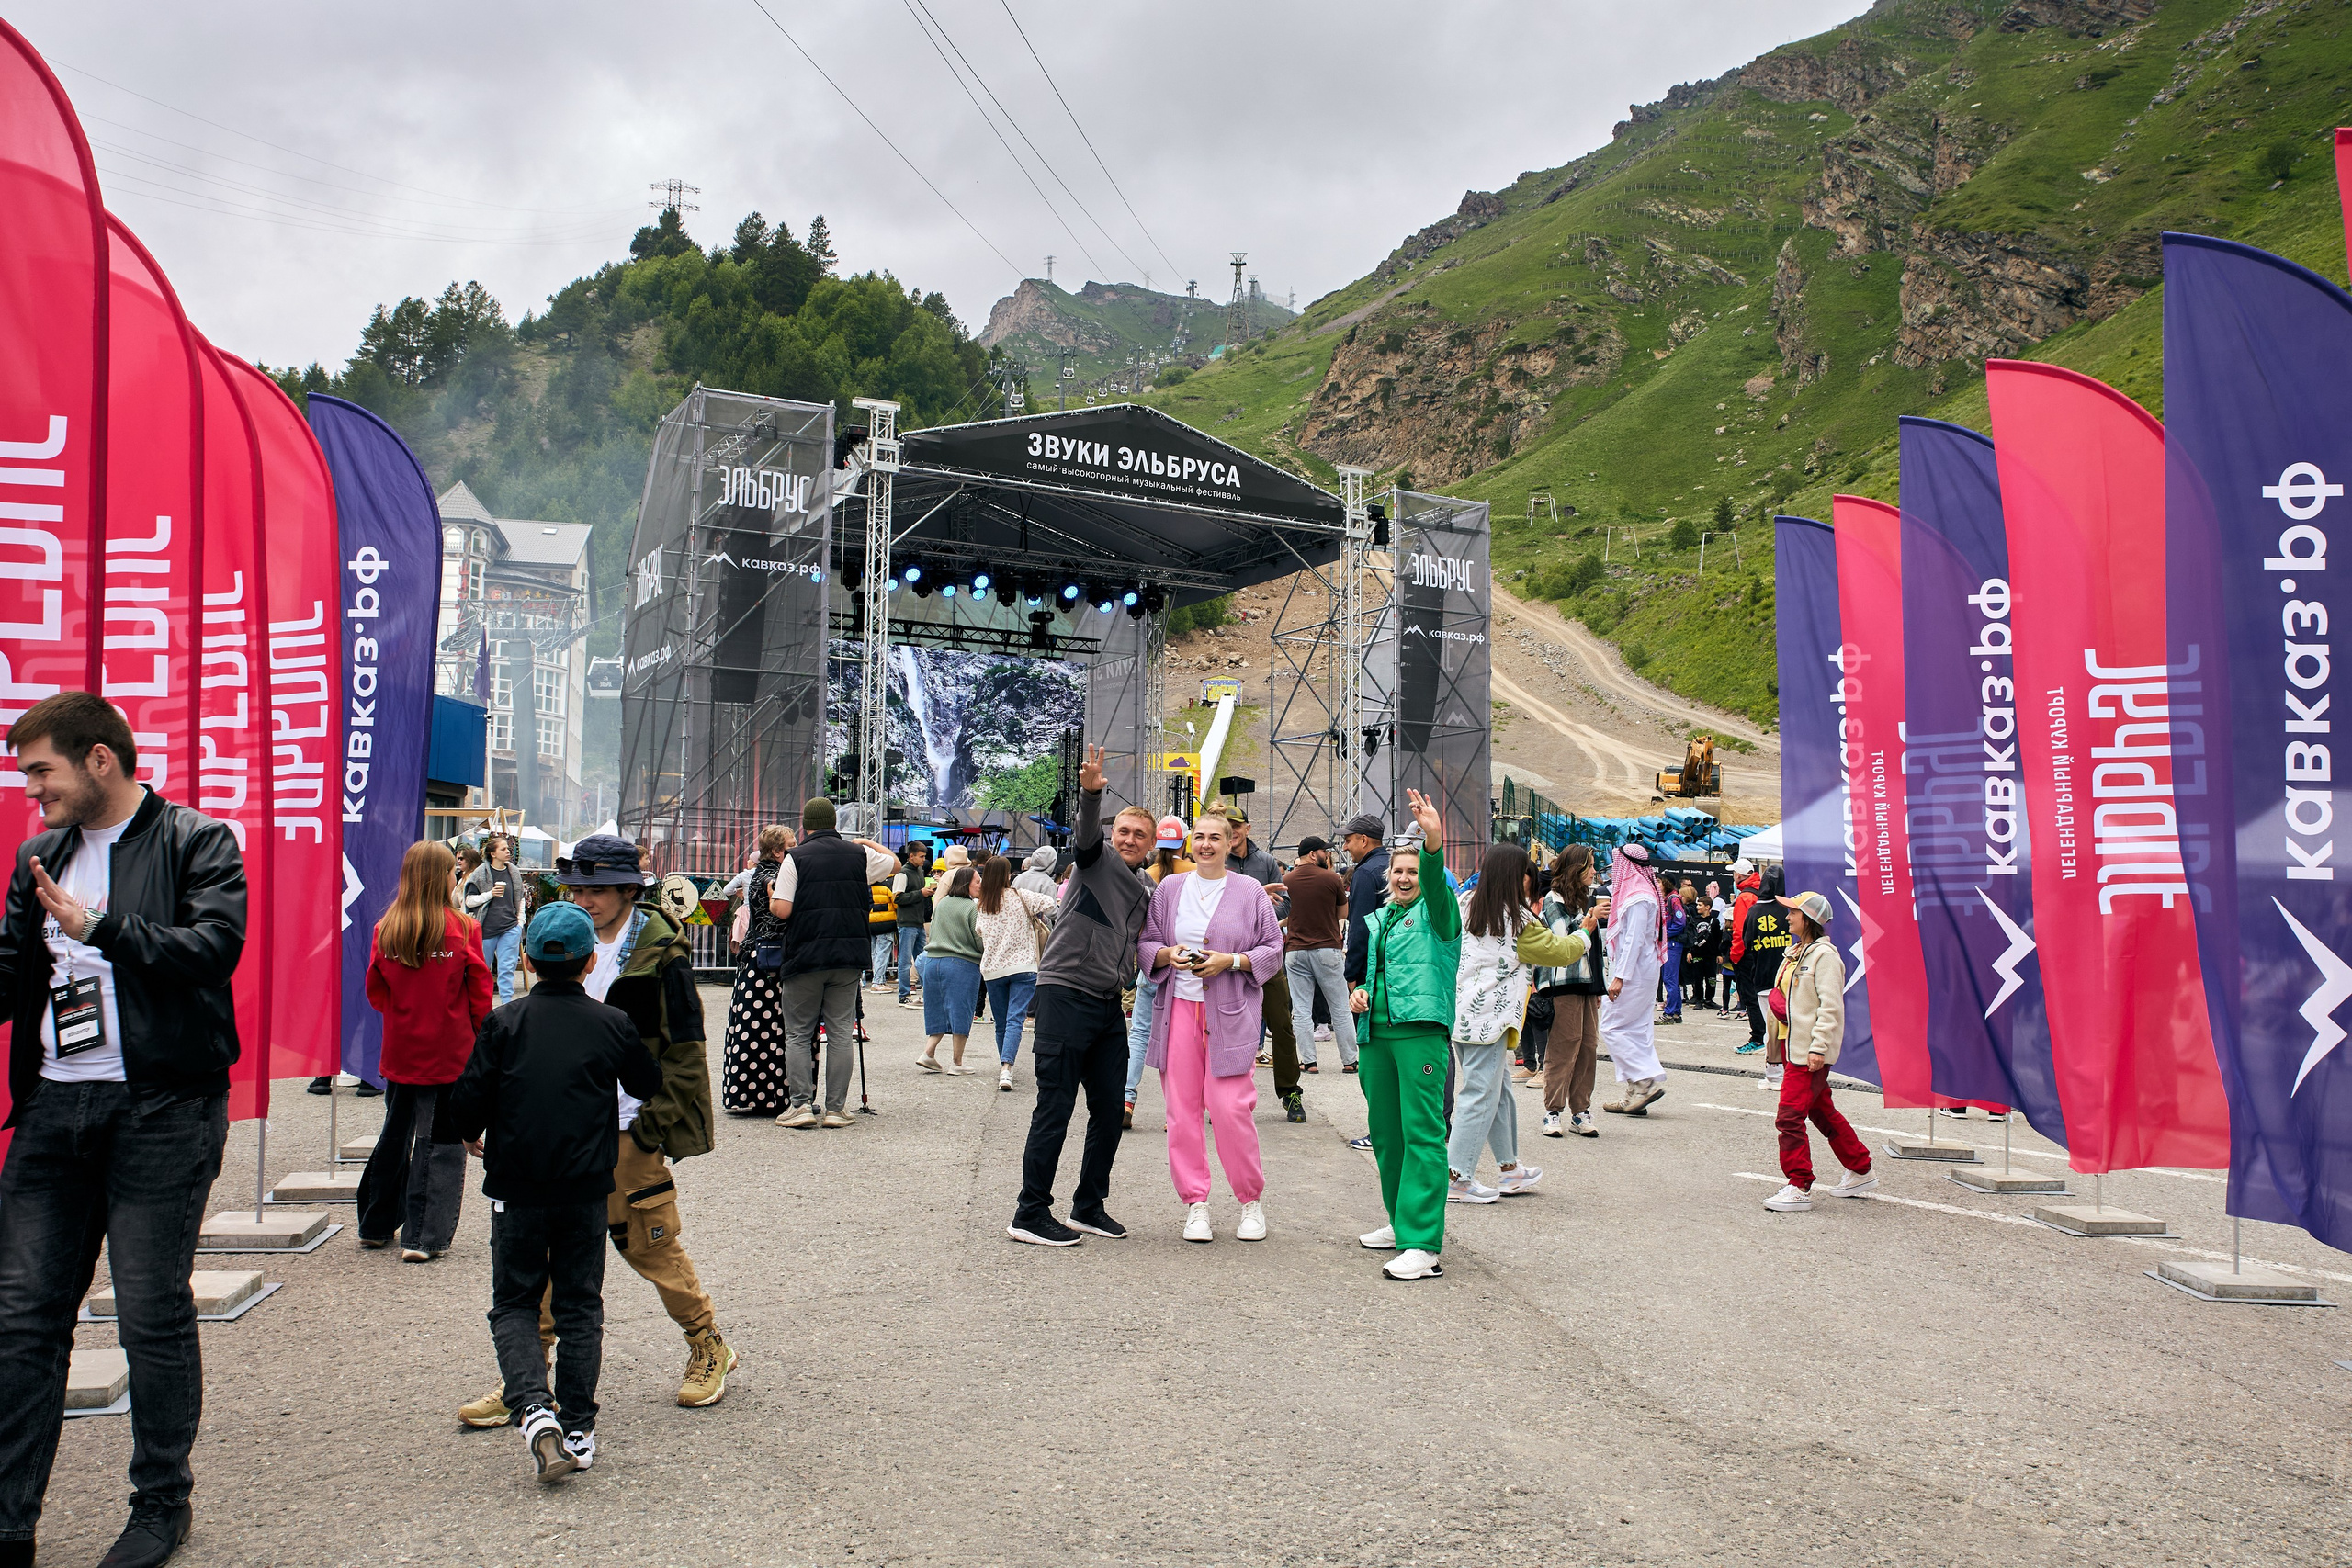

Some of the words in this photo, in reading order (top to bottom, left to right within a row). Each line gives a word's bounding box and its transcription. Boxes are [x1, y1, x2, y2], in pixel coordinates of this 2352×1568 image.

[1027, 432, 1110, 468] ЗВУКИ
[1117, 446, 1241, 488] ЭЛЬБРУСА
[718, 466, 810, 513] ЭЛЬБРУС
[1026, 461, 1058, 473] самый
[1061, 466, 1130, 484] высокогорный
[1132, 476, 1193, 494] музыкальный
[1195, 486, 1241, 501] фестиваль
[741, 557, 822, 577] кавказ.рф
[1411, 553, 1475, 592] ЭЛЬБРУС
[636, 640, 672, 672] кавказ.рф
[1429, 628, 1485, 645] кавказ.рф
